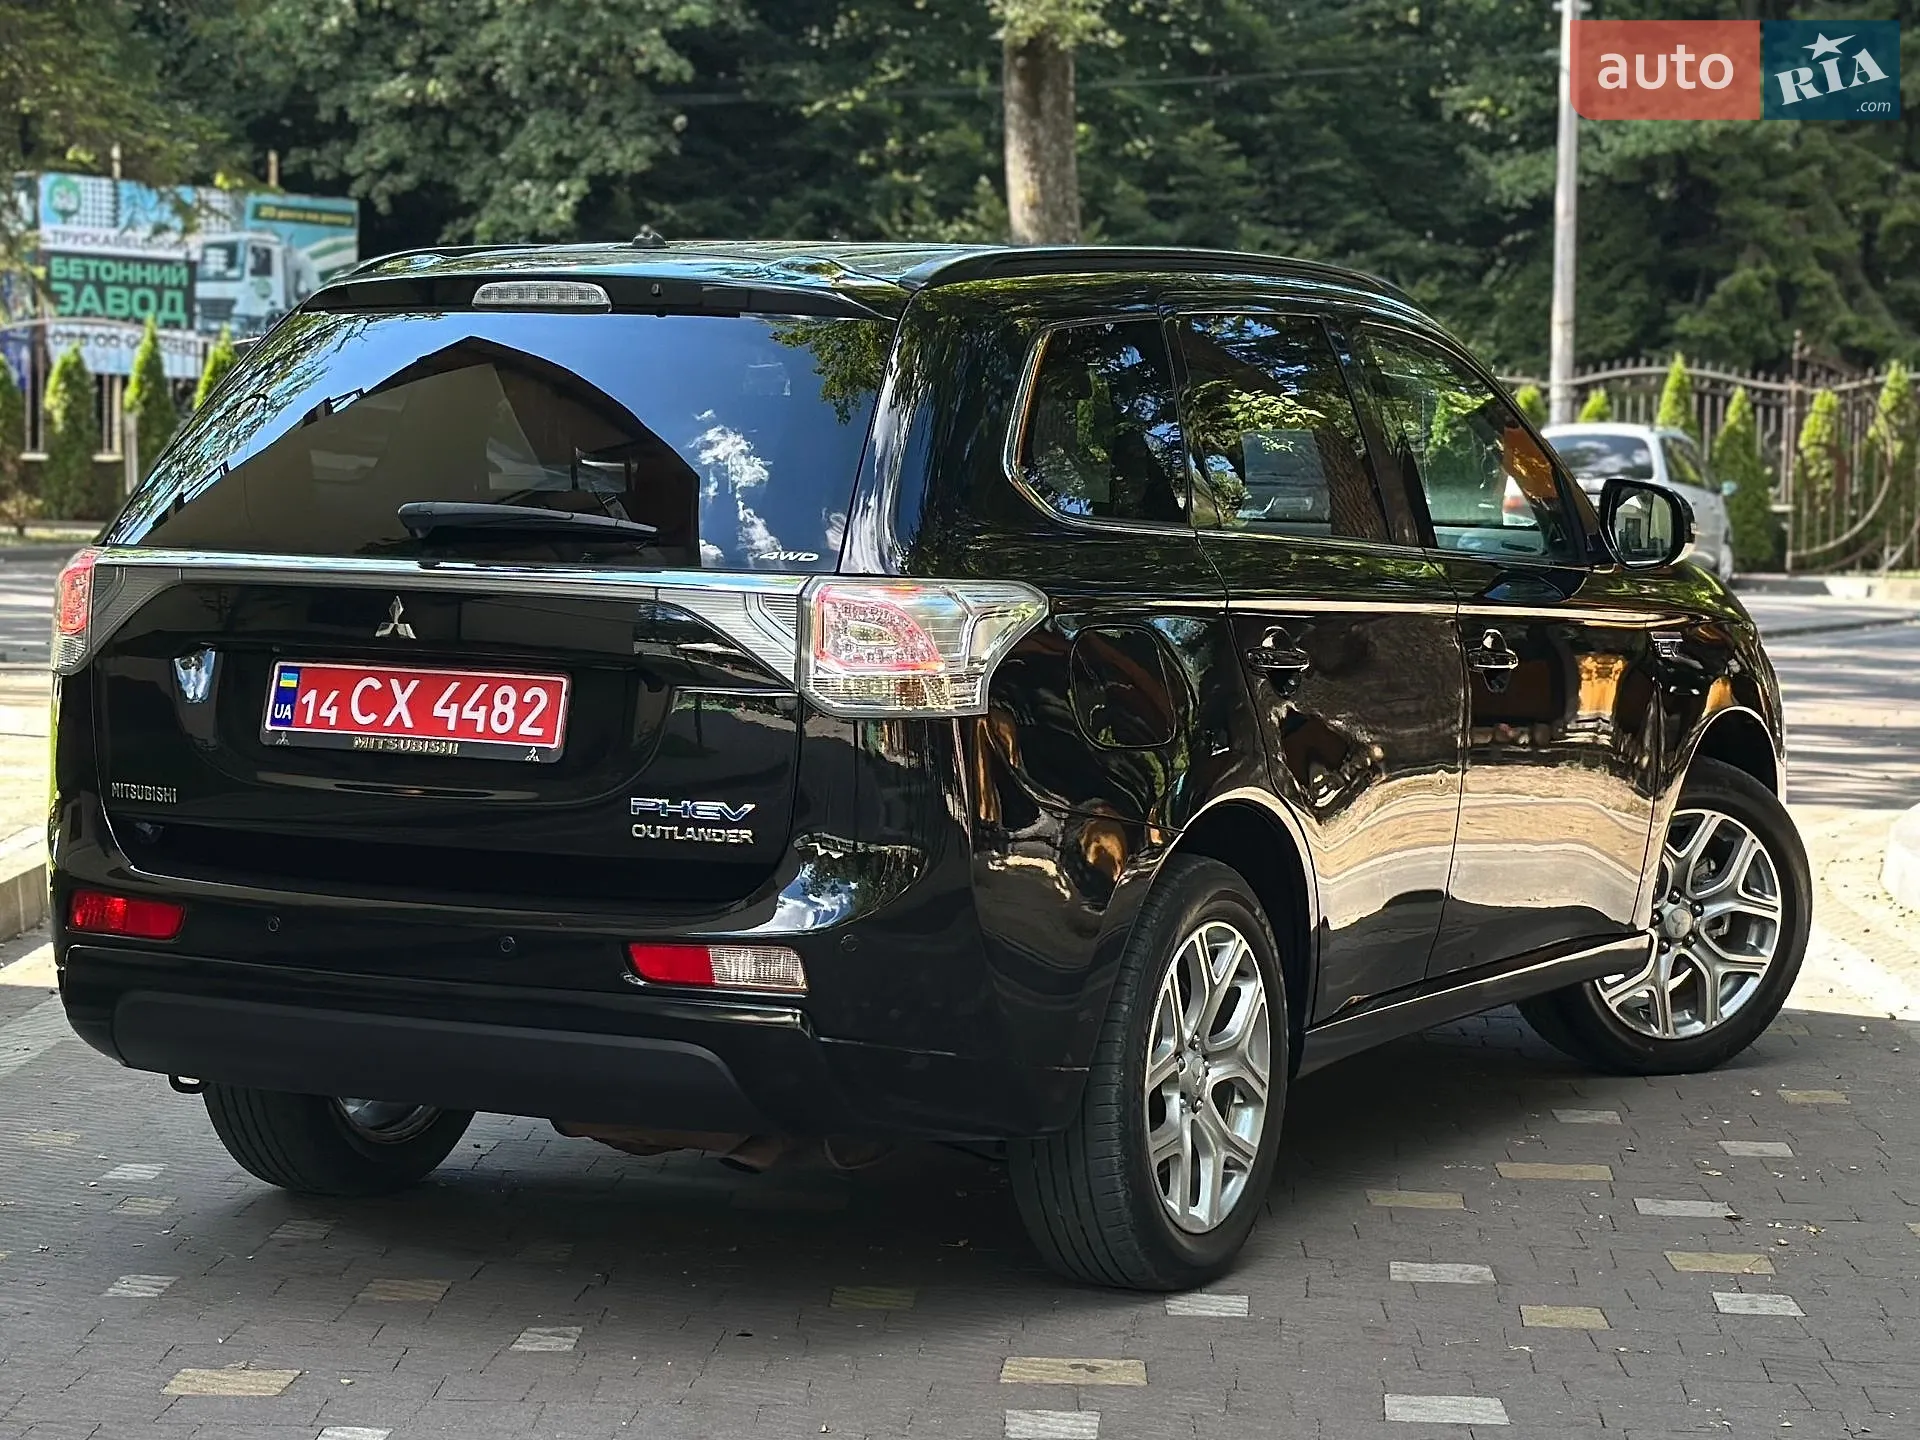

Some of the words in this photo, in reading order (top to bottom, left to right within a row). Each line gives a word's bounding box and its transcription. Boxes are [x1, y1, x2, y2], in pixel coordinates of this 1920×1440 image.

[50, 256, 188, 288] БЕТОННИЙ
[51, 284, 187, 330] ЗАВОД
[760, 551, 819, 562] 4WD
[274, 703, 292, 721] UA
[301, 689, 340, 727] 14
[350, 676, 420, 729] CX
[432, 681, 549, 737] 4482
[352, 736, 459, 755] MITSUBISHI
[111, 782, 177, 804] MITSUBISHI
[630, 797, 756, 822] PHEV
[631, 823, 755, 844] OUTLANDER
